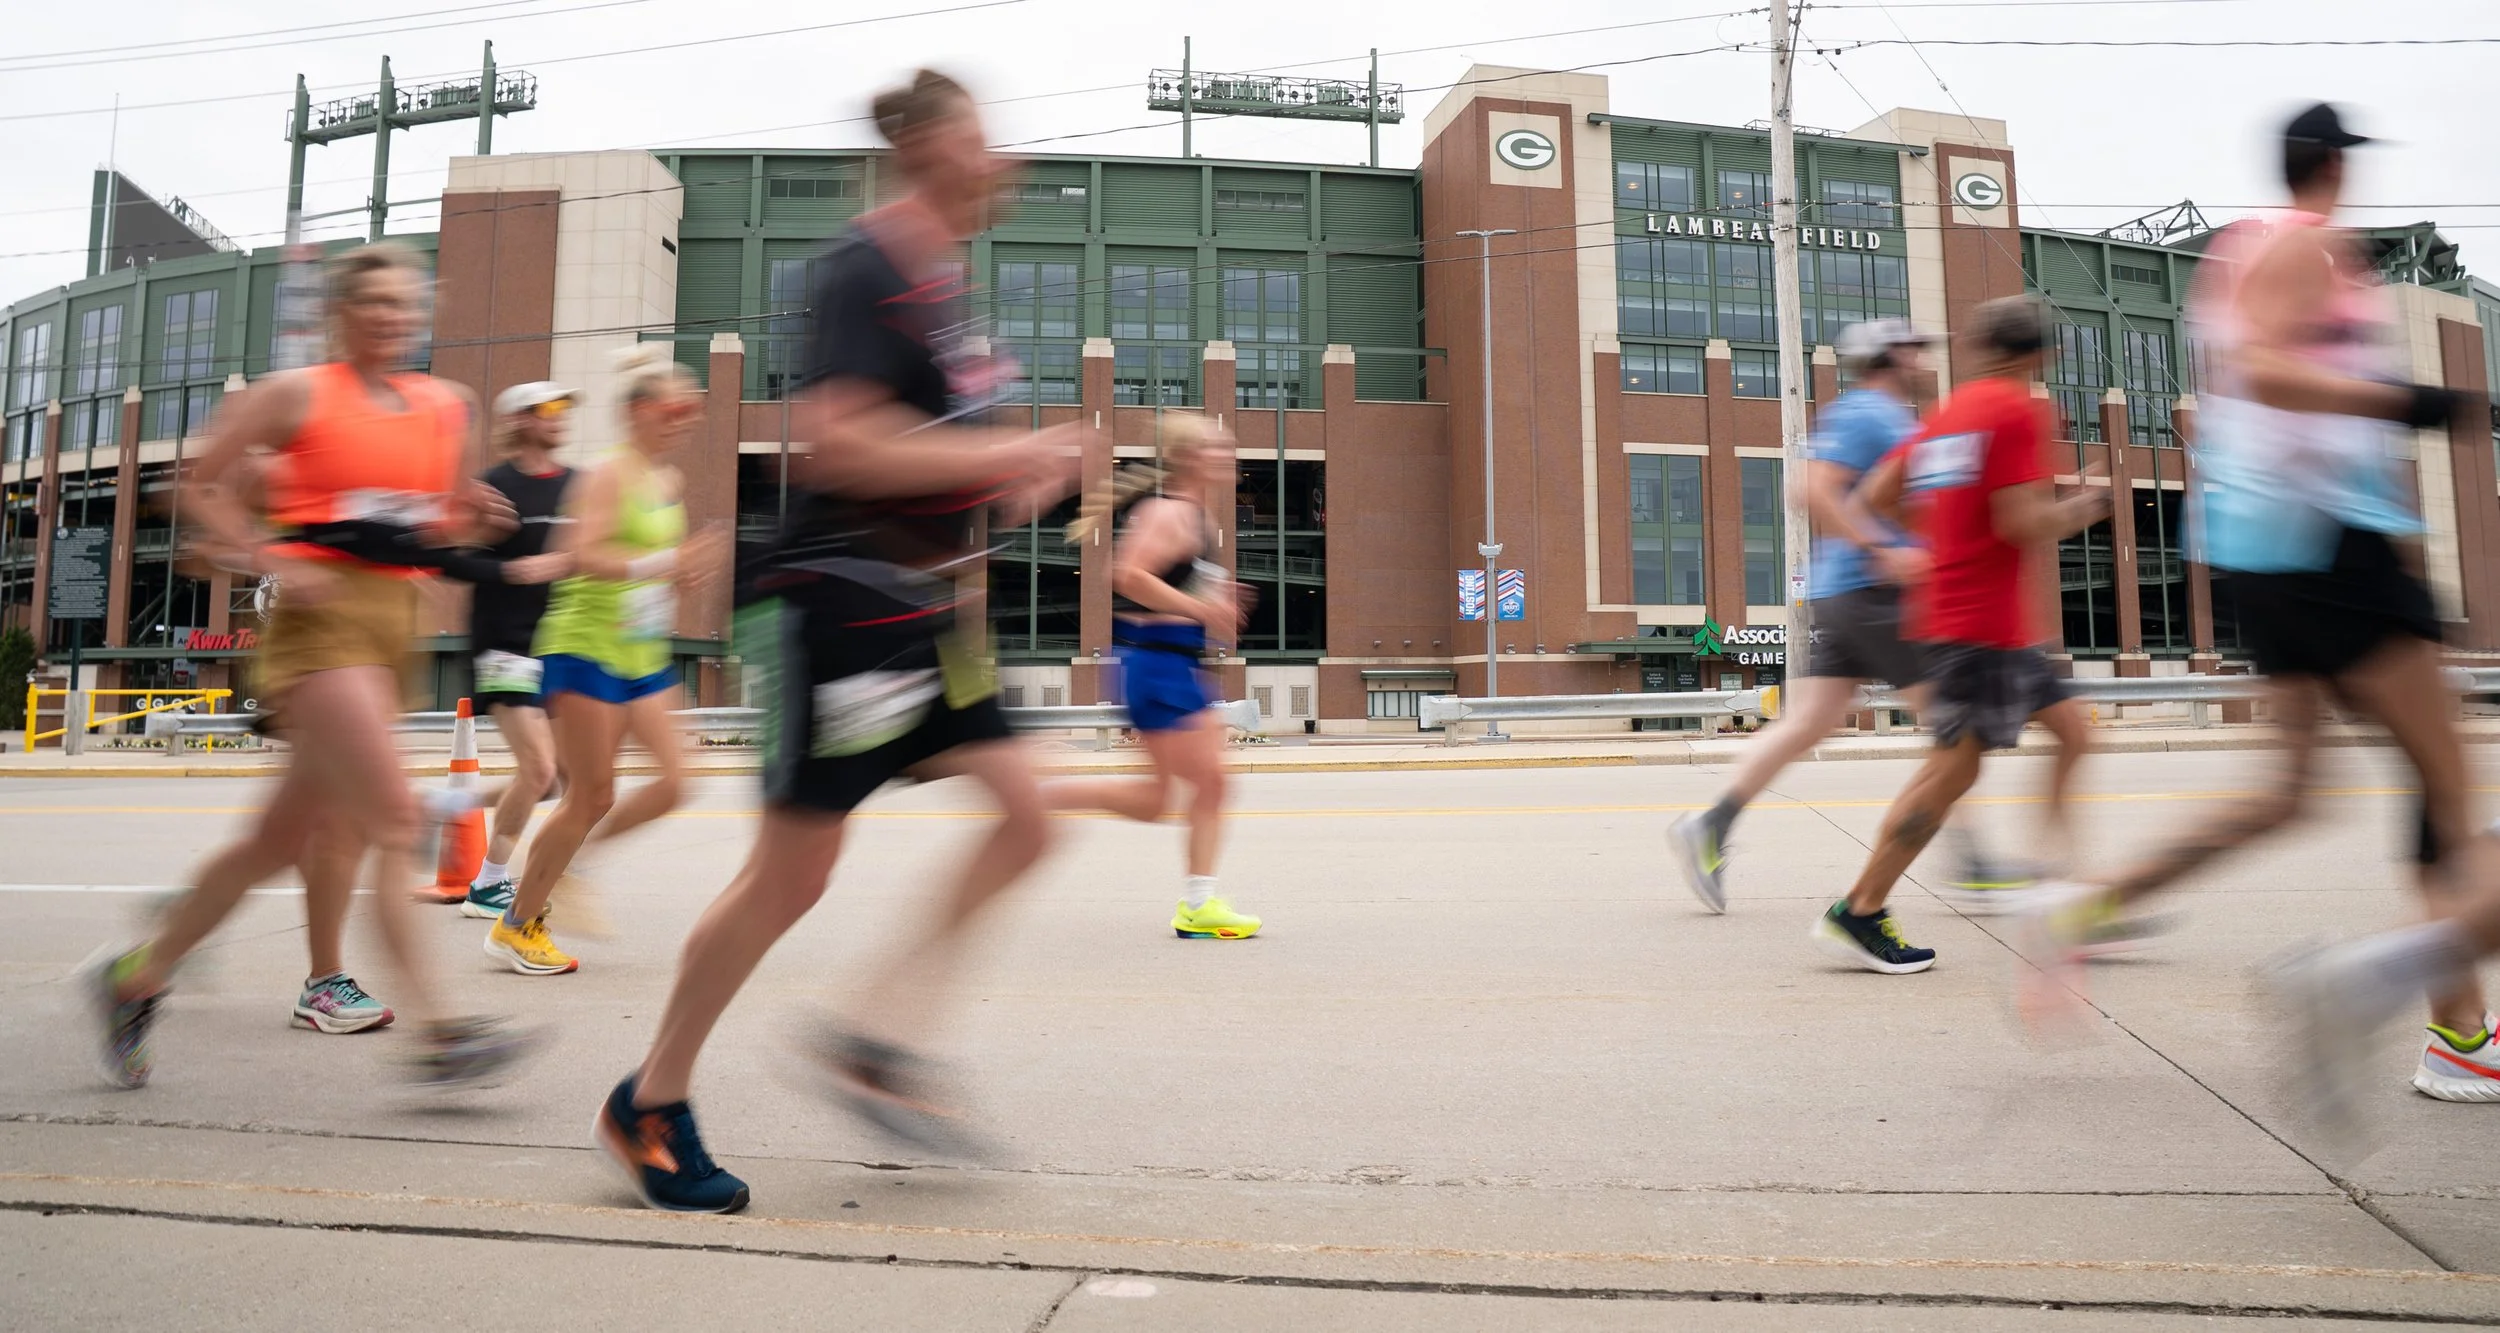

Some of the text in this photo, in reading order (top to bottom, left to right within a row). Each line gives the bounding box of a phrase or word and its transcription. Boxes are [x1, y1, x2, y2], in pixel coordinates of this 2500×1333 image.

[1497, 130, 1555, 169] G
[1956, 174, 2002, 208] G
[1801, 227, 1881, 250] FIELD
[1465, 575, 1475, 615] HOSTING
[1723, 624, 1824, 645] Associ
[1739, 652, 1785, 665] GAME
